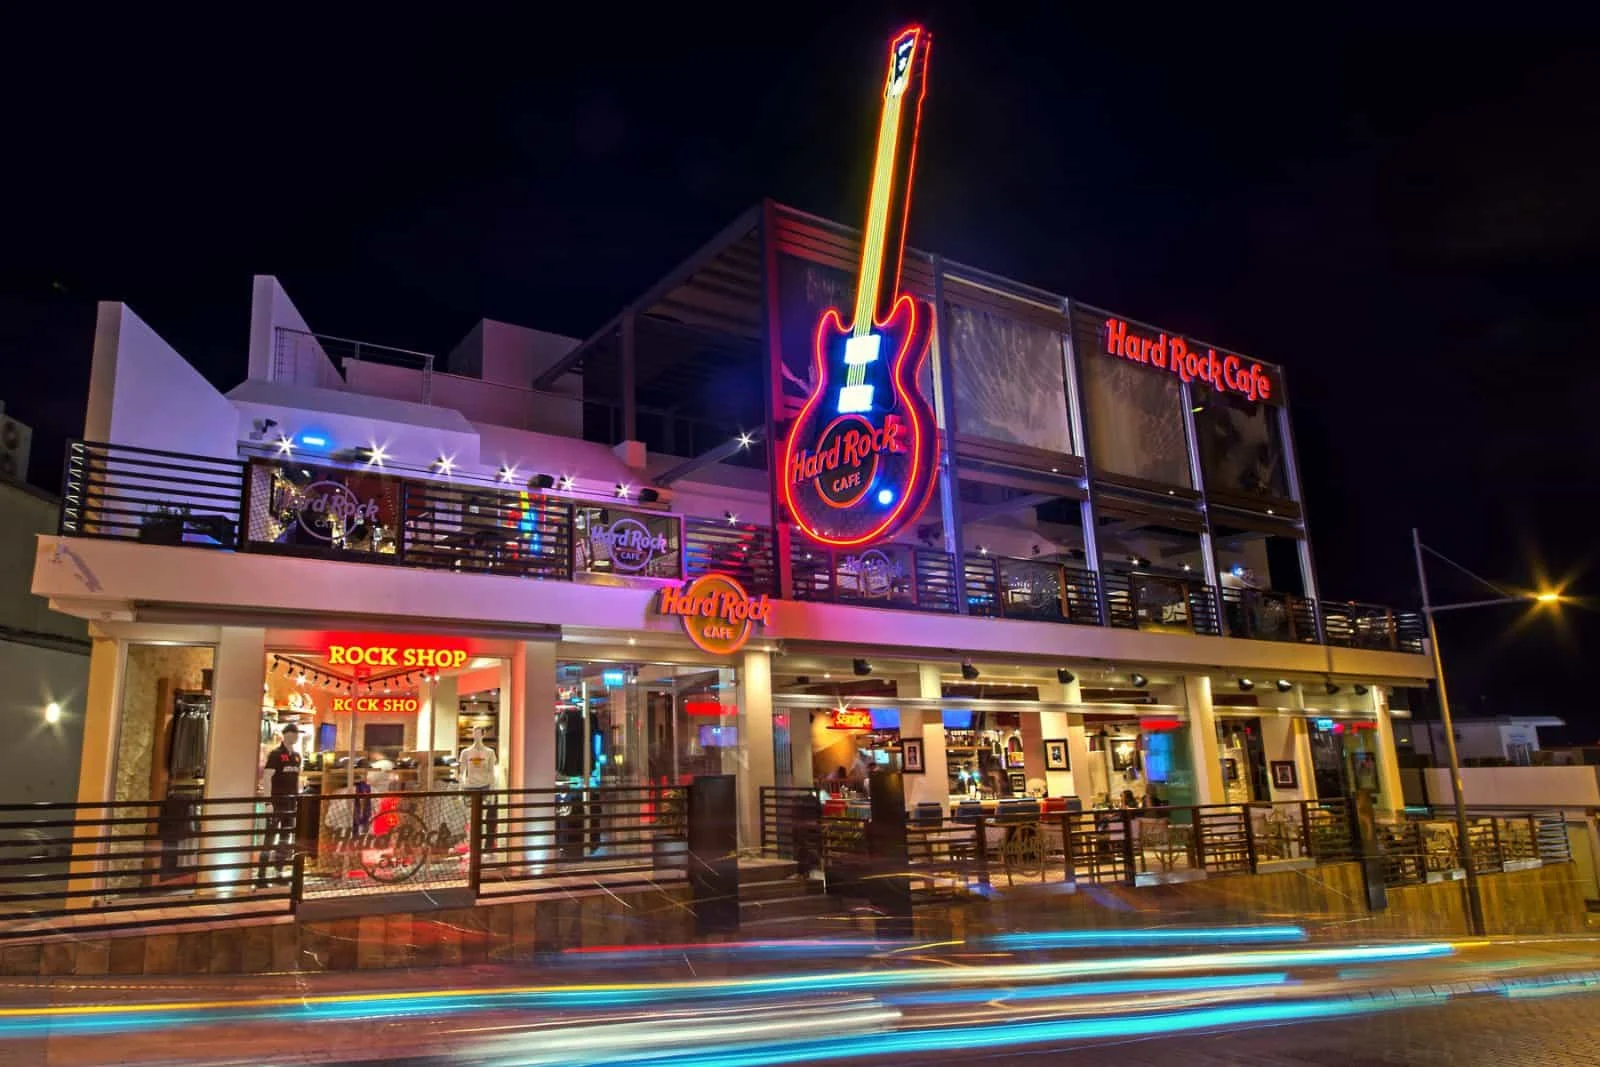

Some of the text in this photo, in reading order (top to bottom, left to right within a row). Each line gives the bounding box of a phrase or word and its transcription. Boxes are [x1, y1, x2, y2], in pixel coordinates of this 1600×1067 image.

[1105, 317, 1271, 400] Hard Rock Cafe
[791, 414, 898, 484] Hard Rock
[832, 471, 861, 492] CAFE
[591, 526, 667, 554] Hard Rock
[661, 586, 772, 626] Hard Rock
[703, 625, 735, 639] CAFE
[329, 645, 467, 668] ROCK SHOP
[384, 699, 417, 712] SHO
